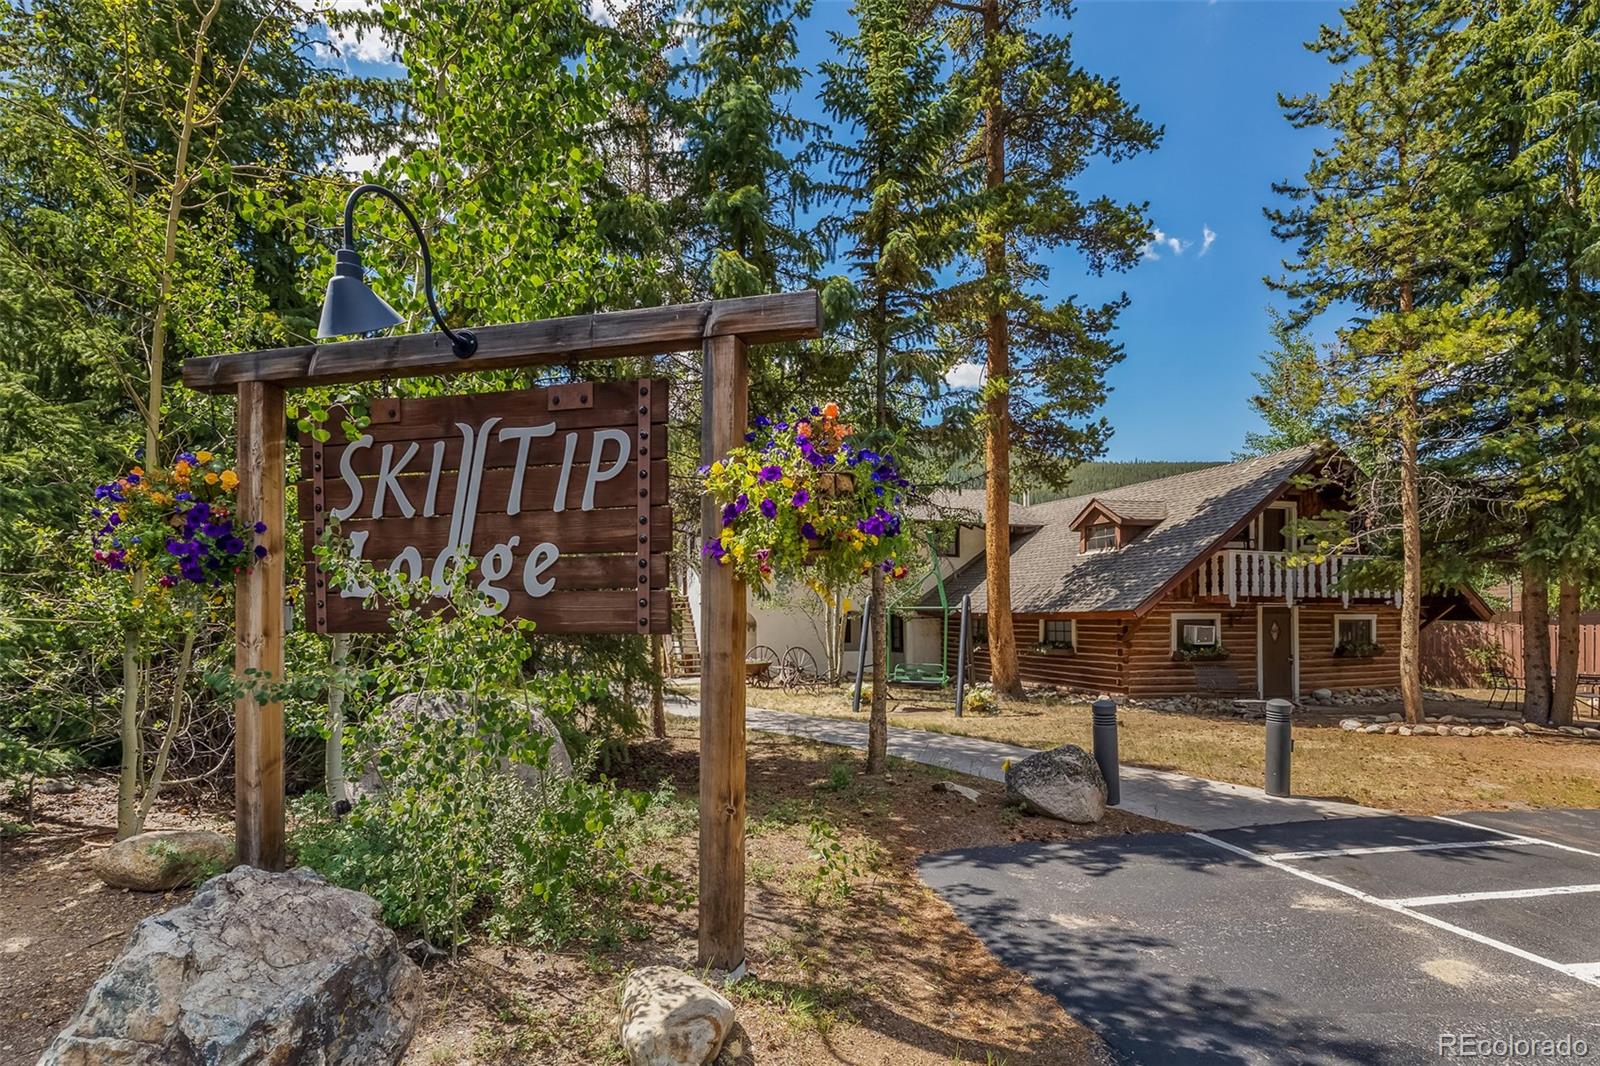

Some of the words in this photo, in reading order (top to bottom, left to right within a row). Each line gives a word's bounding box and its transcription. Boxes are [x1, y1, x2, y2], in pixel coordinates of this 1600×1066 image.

[331, 434, 445, 521] SKI
[499, 421, 631, 516] TIP
[340, 530, 560, 616] Lodge
